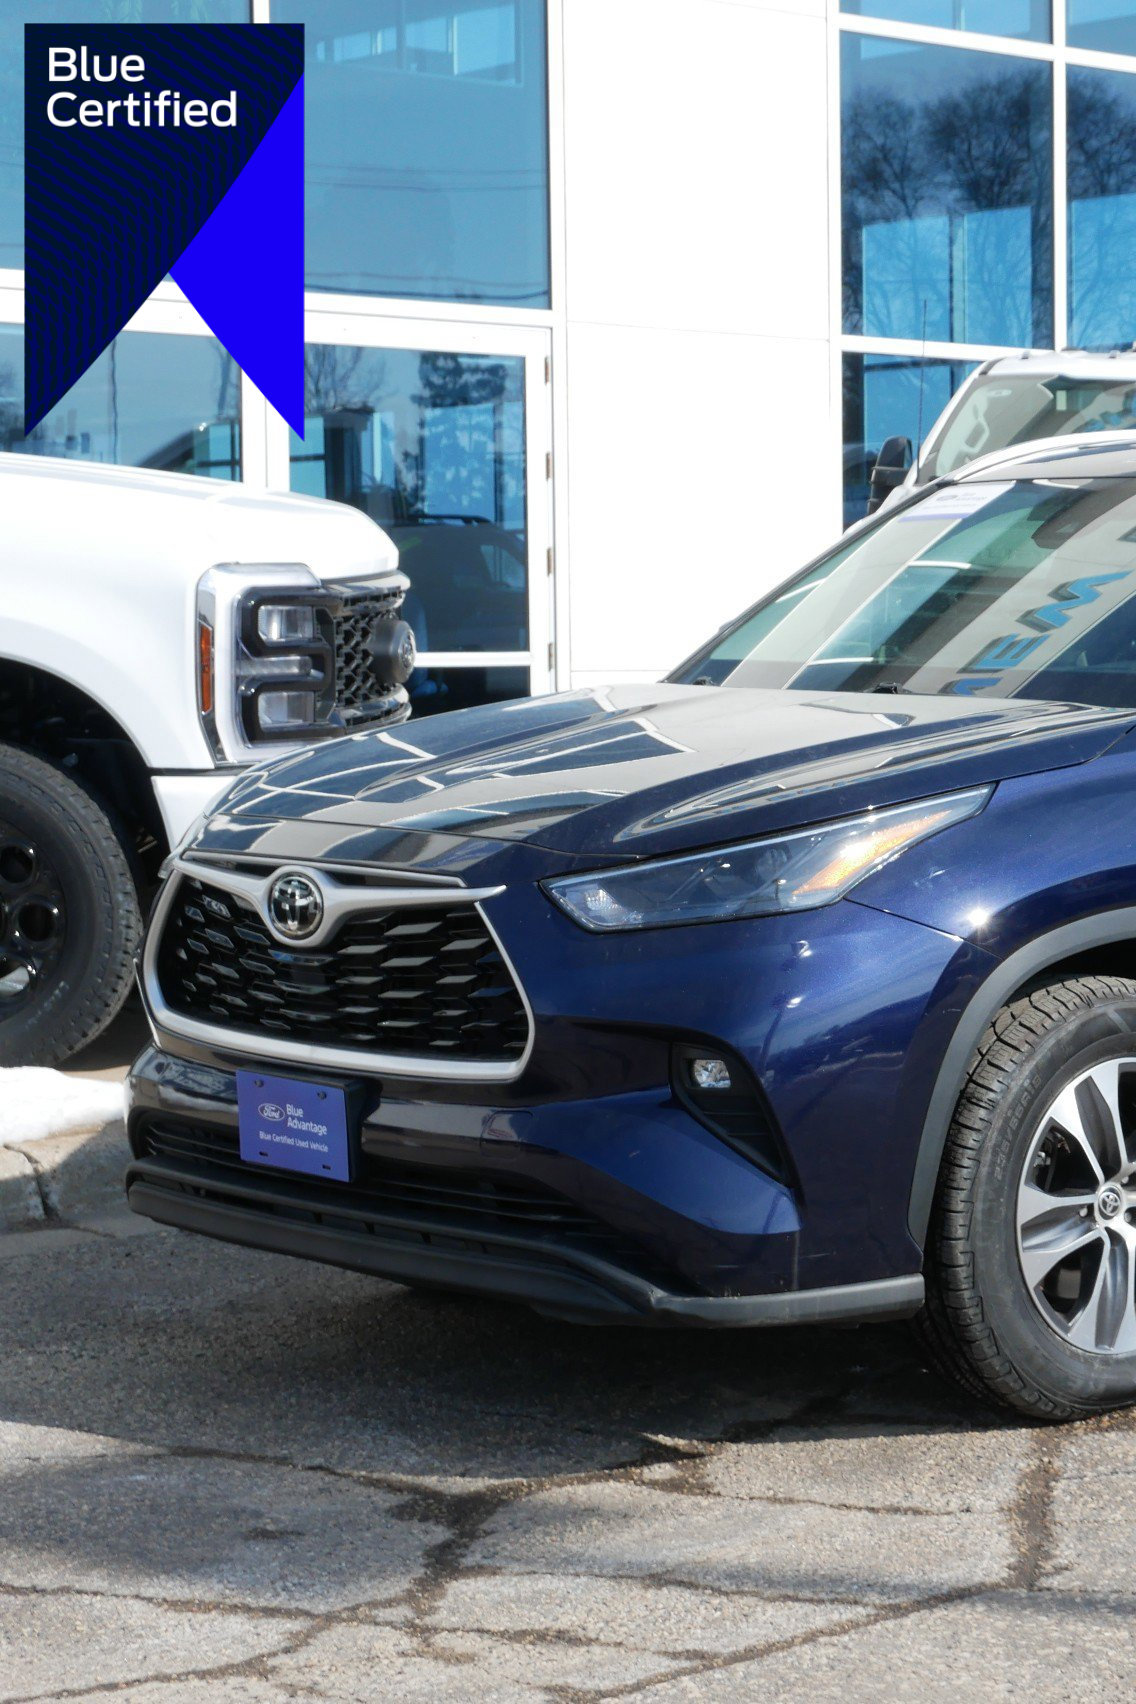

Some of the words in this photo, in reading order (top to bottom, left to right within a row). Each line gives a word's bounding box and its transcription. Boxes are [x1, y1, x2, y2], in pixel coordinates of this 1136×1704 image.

[286, 1104, 303, 1117] Blue
[287, 1117, 327, 1136] Advantage
[259, 1131, 271, 1140] Blue
[272, 1133, 294, 1145] Certified
[295, 1138, 308, 1148] Used
[310, 1141, 328, 1152] Vehicle
